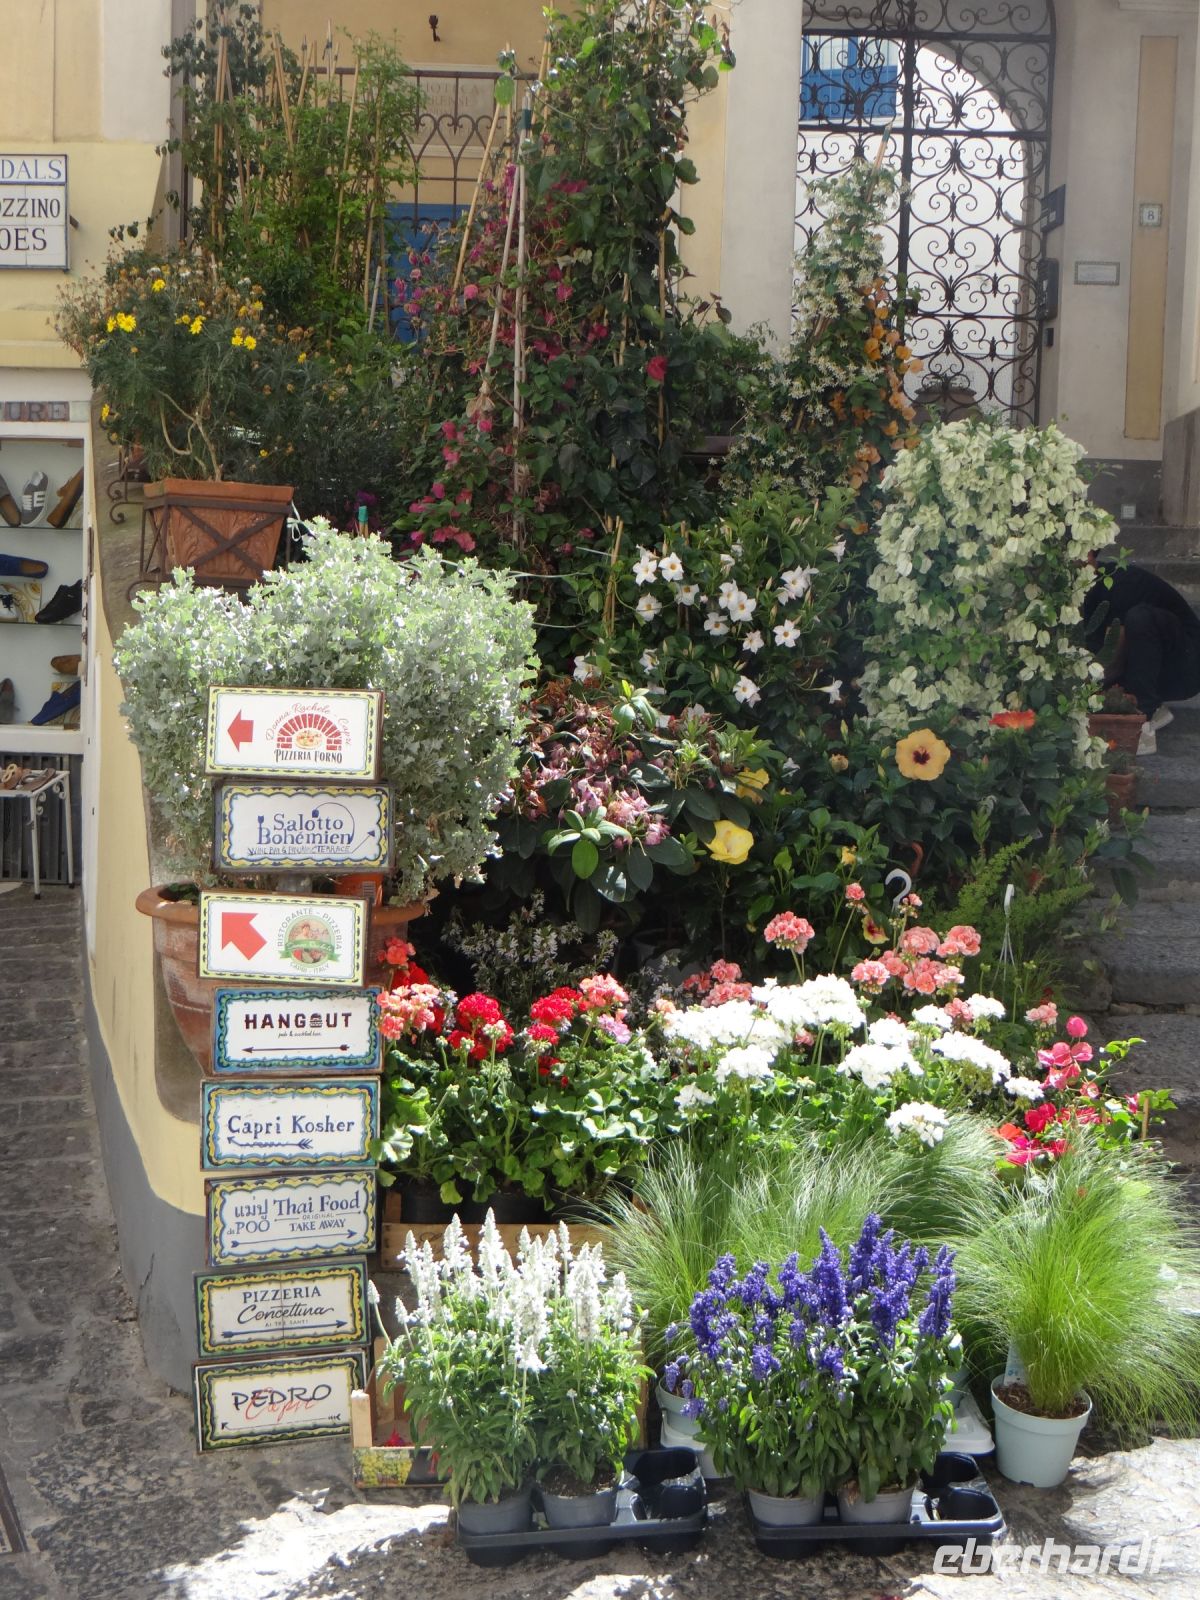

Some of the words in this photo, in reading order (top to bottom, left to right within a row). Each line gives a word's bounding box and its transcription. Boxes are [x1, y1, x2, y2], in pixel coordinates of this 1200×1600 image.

[0, 159, 62, 180] DALS
[0, 198, 61, 218] ZZINO
[0, 228, 47, 251] OES
[0, 402, 65, 421] URE
[274, 749, 312, 763] PIZZERIA
[314, 750, 343, 764] FORNO
[273, 813, 344, 832] Salotto
[277, 908, 313, 948] RISTORANTE
[322, 913, 343, 950] PIZZERIA
[227, 1115, 281, 1139] Capri
[291, 1115, 355, 1134] Kosher
[273, 1196, 314, 1216] Thai
[320, 1190, 360, 1212] Food
[235, 1219, 270, 1235] POO
[289, 1222, 316, 1232] TAKE
[319, 1218, 346, 1230] AWAY
[243, 1285, 321, 1304] PIZZERIA
[232, 1384, 332, 1411] PEDRO
